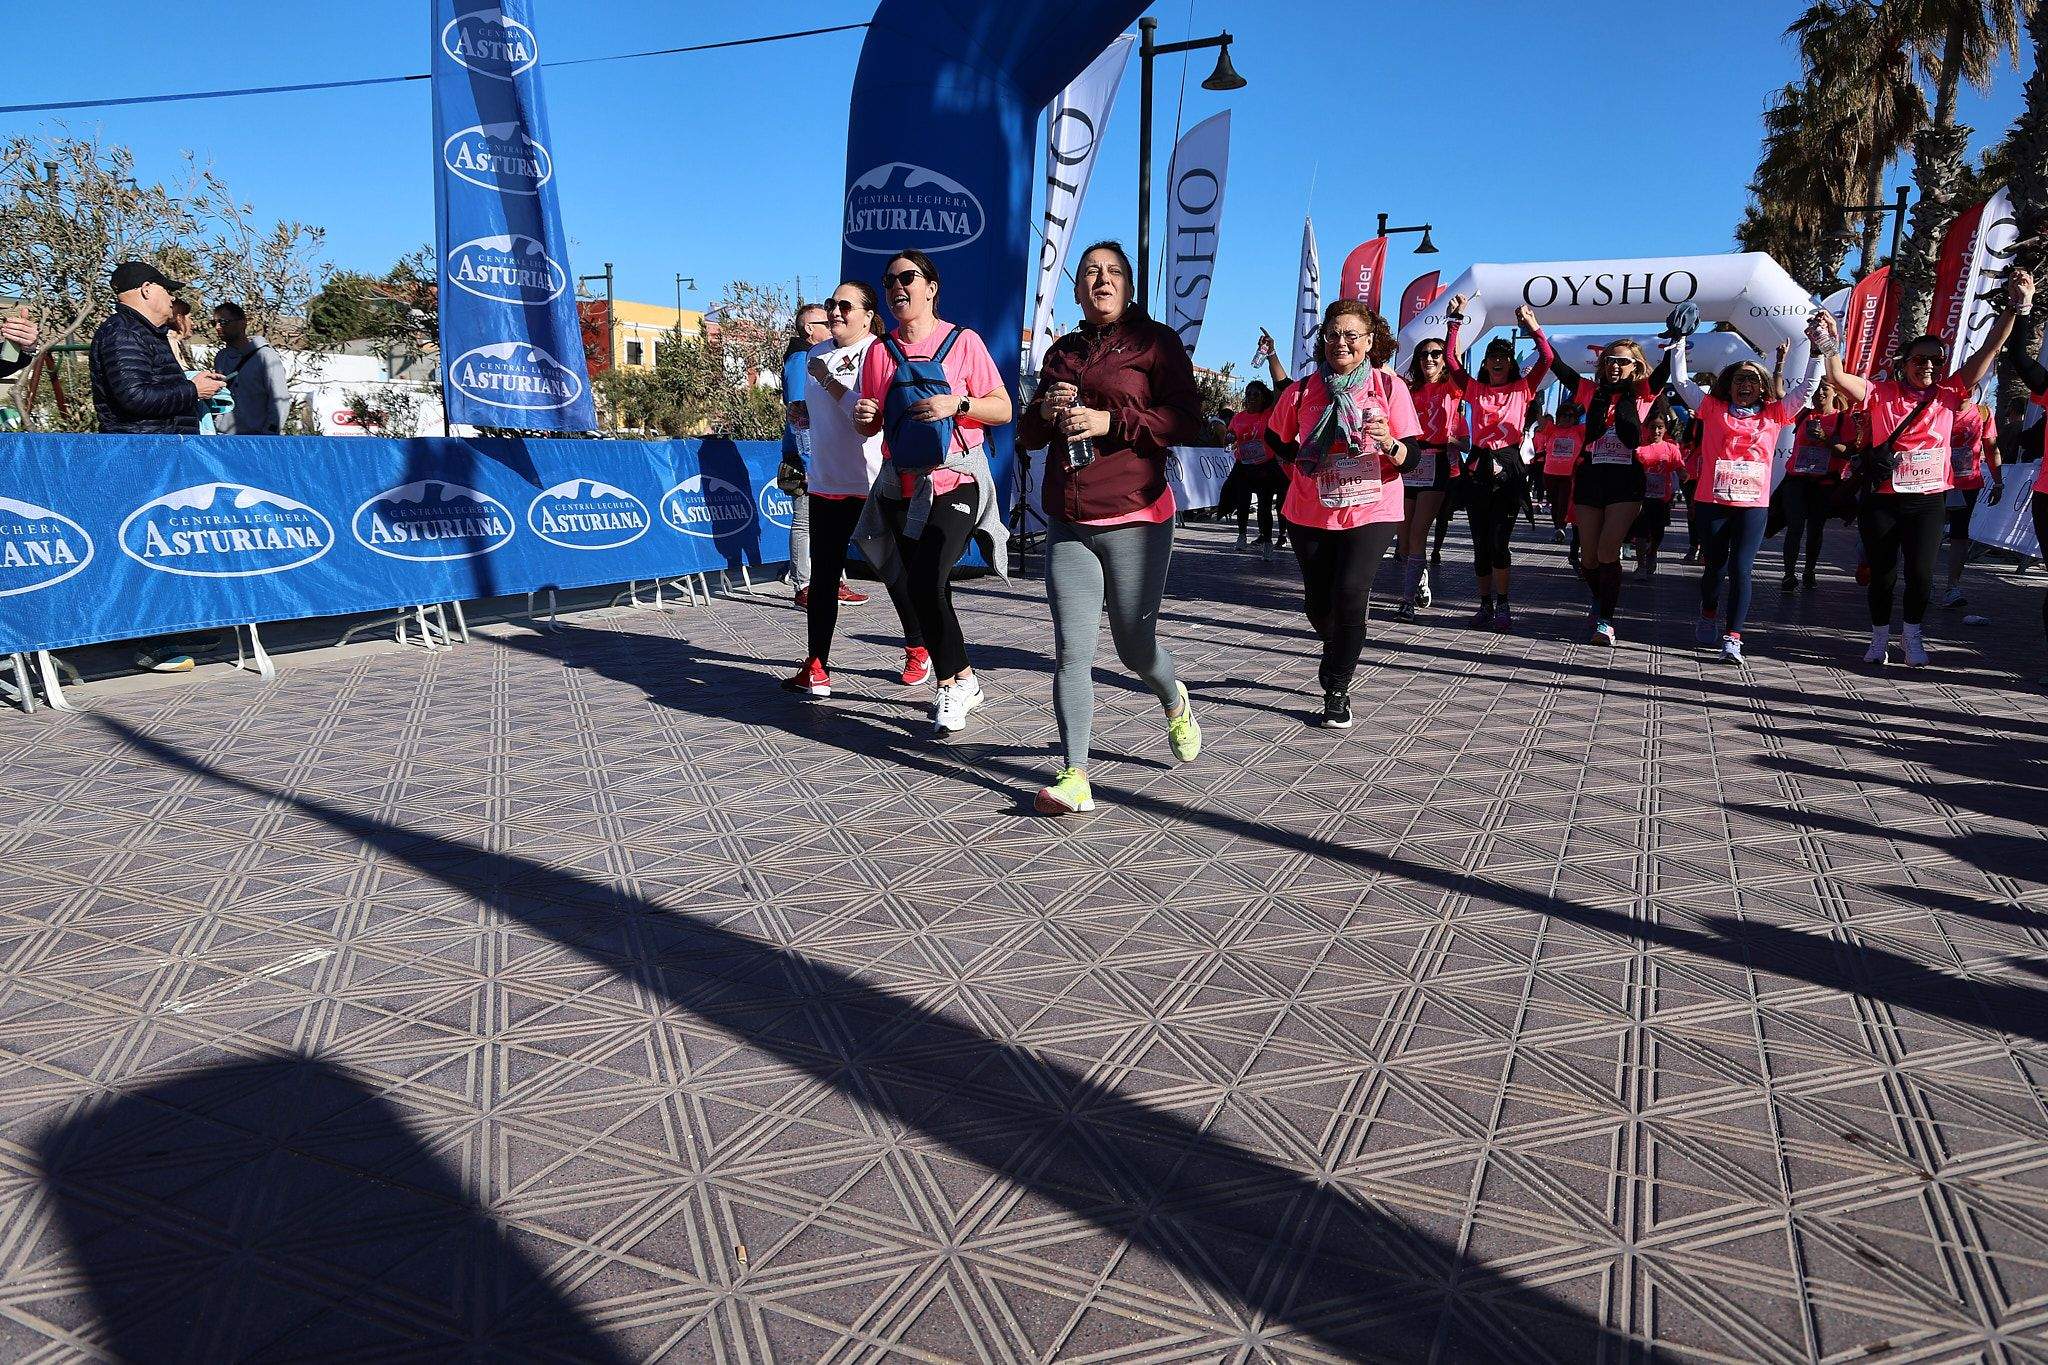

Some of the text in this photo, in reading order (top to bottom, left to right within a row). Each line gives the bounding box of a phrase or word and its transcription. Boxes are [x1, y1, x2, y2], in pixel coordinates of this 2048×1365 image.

[845, 201, 972, 235] ASTURIANA
[1174, 168, 1218, 357] YSHO
[1523, 271, 1698, 307] OYSHO
[1750, 305, 1807, 318] OYSHO
[1857, 294, 1877, 371] Santander
[461, 361, 573, 397] ASTURIANA
[480, 362, 527, 373] CENTRAL
[1339, 475, 1362, 487] 016
[1731, 478, 1749, 486] 016
[1911, 467, 1931, 477] 016
[390, 505, 496, 518] CENTRAL LECHERA
[555, 501, 635, 511] CENTRAL LECHERA
[672, 500, 749, 524] ASTURIANA
[169, 513, 310, 527] CENTRAL LECHERA
[369, 512, 508, 544] ASTURIANA
[541, 506, 645, 533] ASTURIANA
[143, 520, 324, 558] ASTURIANA
